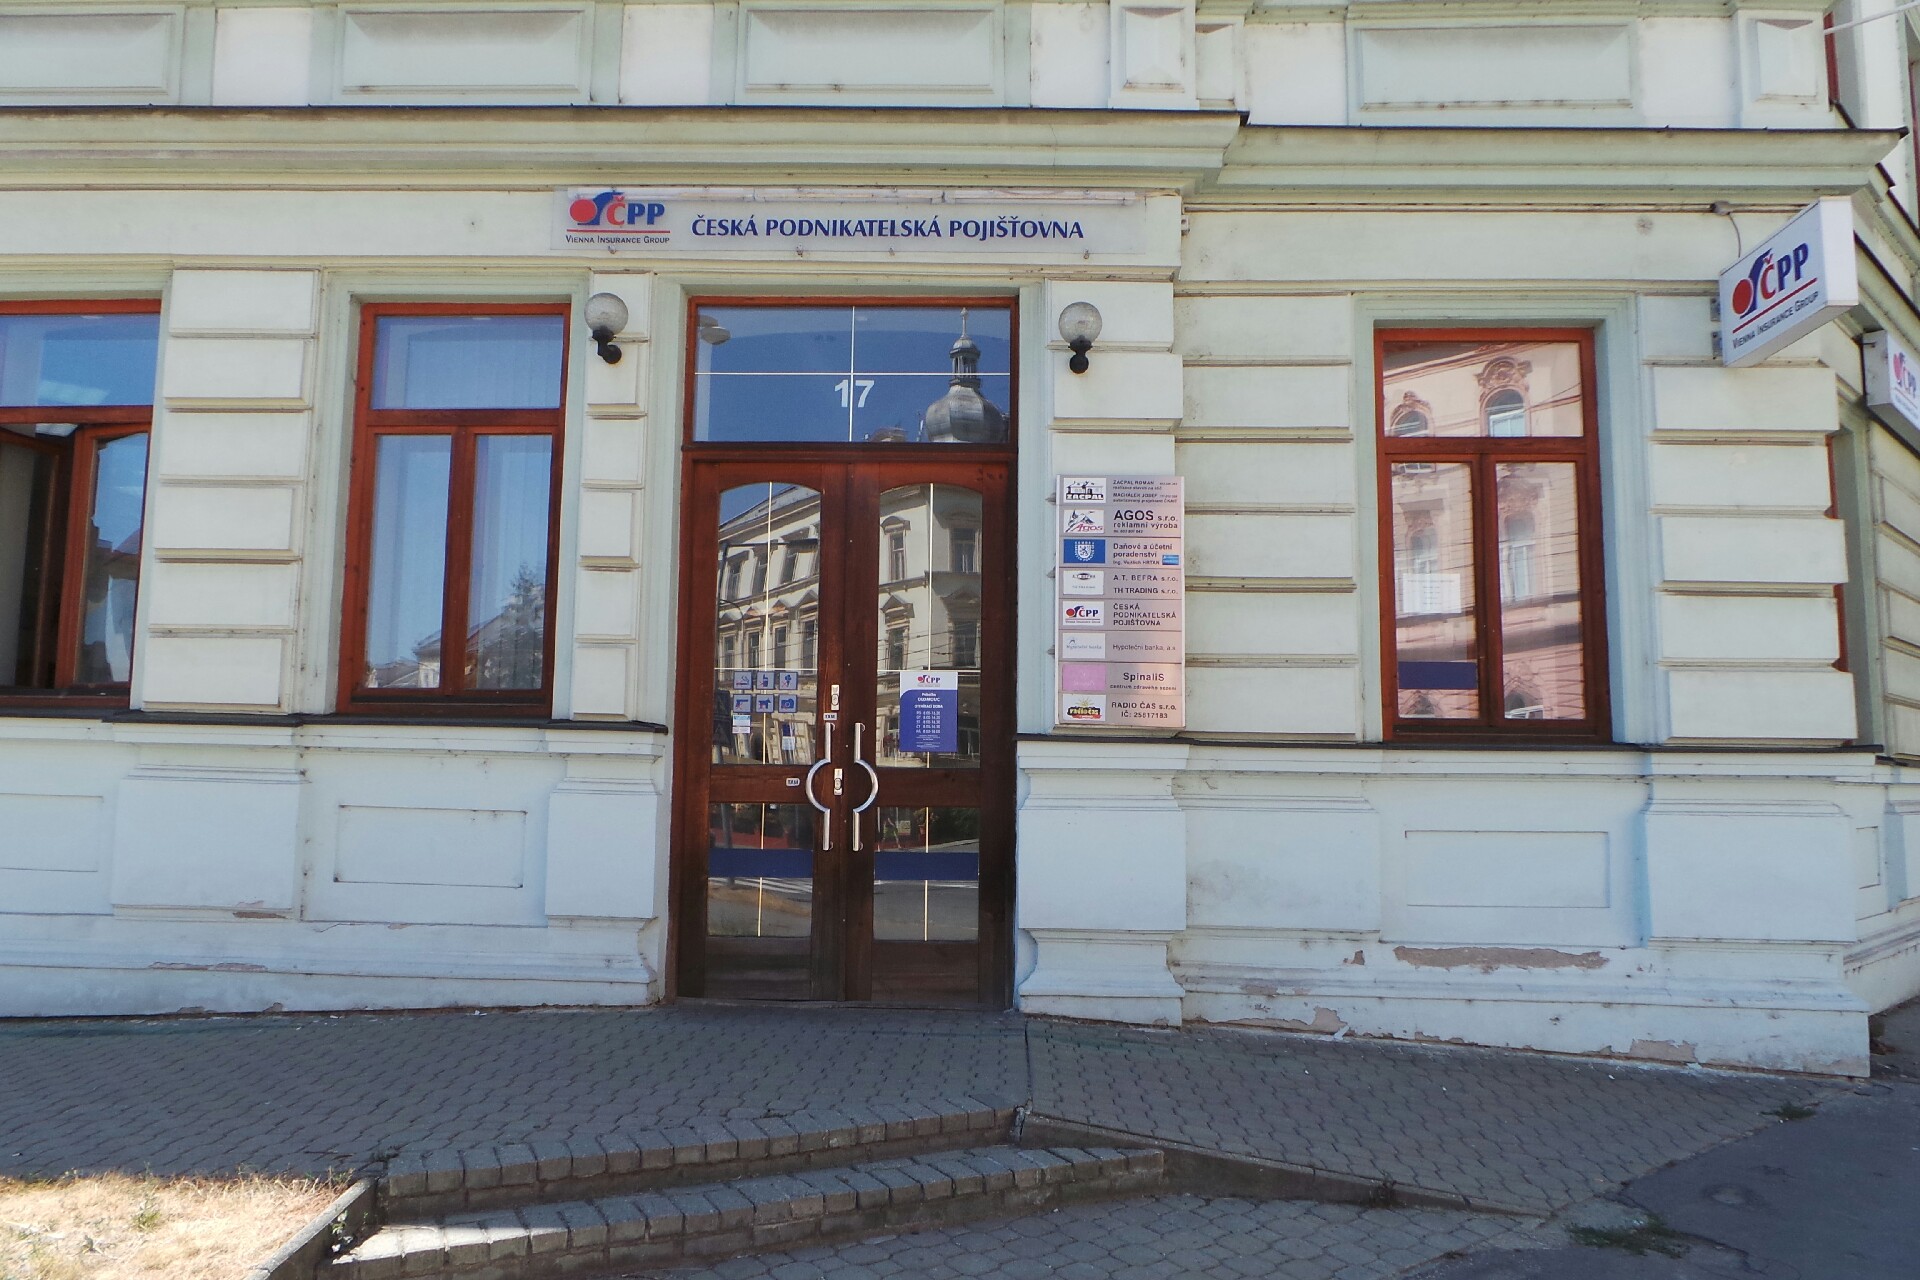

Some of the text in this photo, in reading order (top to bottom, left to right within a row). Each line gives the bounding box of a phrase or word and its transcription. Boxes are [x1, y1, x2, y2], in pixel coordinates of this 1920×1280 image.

[606, 195, 665, 226] ČPP
[691, 214, 1084, 241] ČESKÁ PODNIKATELSKÁ POJIŠŤOVNA
[1760, 242, 1810, 300] ČPP
[834, 379, 875, 408] 17
[1113, 509, 1154, 521] AGOS
[1150, 522, 1178, 530] výroba
[1113, 542, 1141, 550] Daňové
[1113, 602, 1140, 610] ČESKÁ
[1078, 607, 1099, 617] ČPP
[1113, 611, 1177, 619] PODNIKATELSKÁ
[1113, 618, 1161, 626] POJIŠŤOVNA
[1123, 672, 1165, 682] SpinaliS
[1111, 701, 1138, 709] RADIO
[1139, 701, 1156, 710] ČAS
